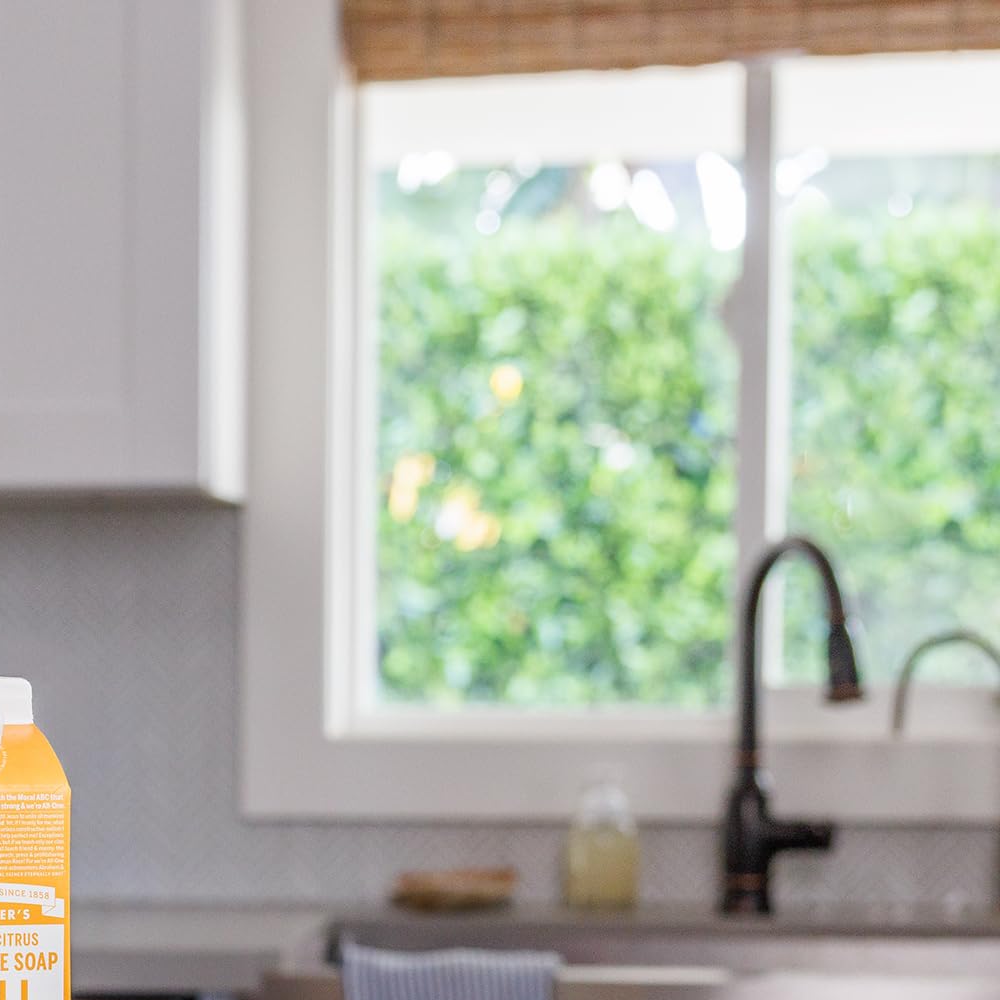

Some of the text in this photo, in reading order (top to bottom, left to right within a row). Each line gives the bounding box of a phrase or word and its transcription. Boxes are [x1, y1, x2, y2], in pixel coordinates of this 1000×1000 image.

[36, 793, 50, 801] ABC
[0, 889, 27, 898] SINCE
[29, 891, 50, 900] 1858
[14, 952, 58, 971] SOAP
